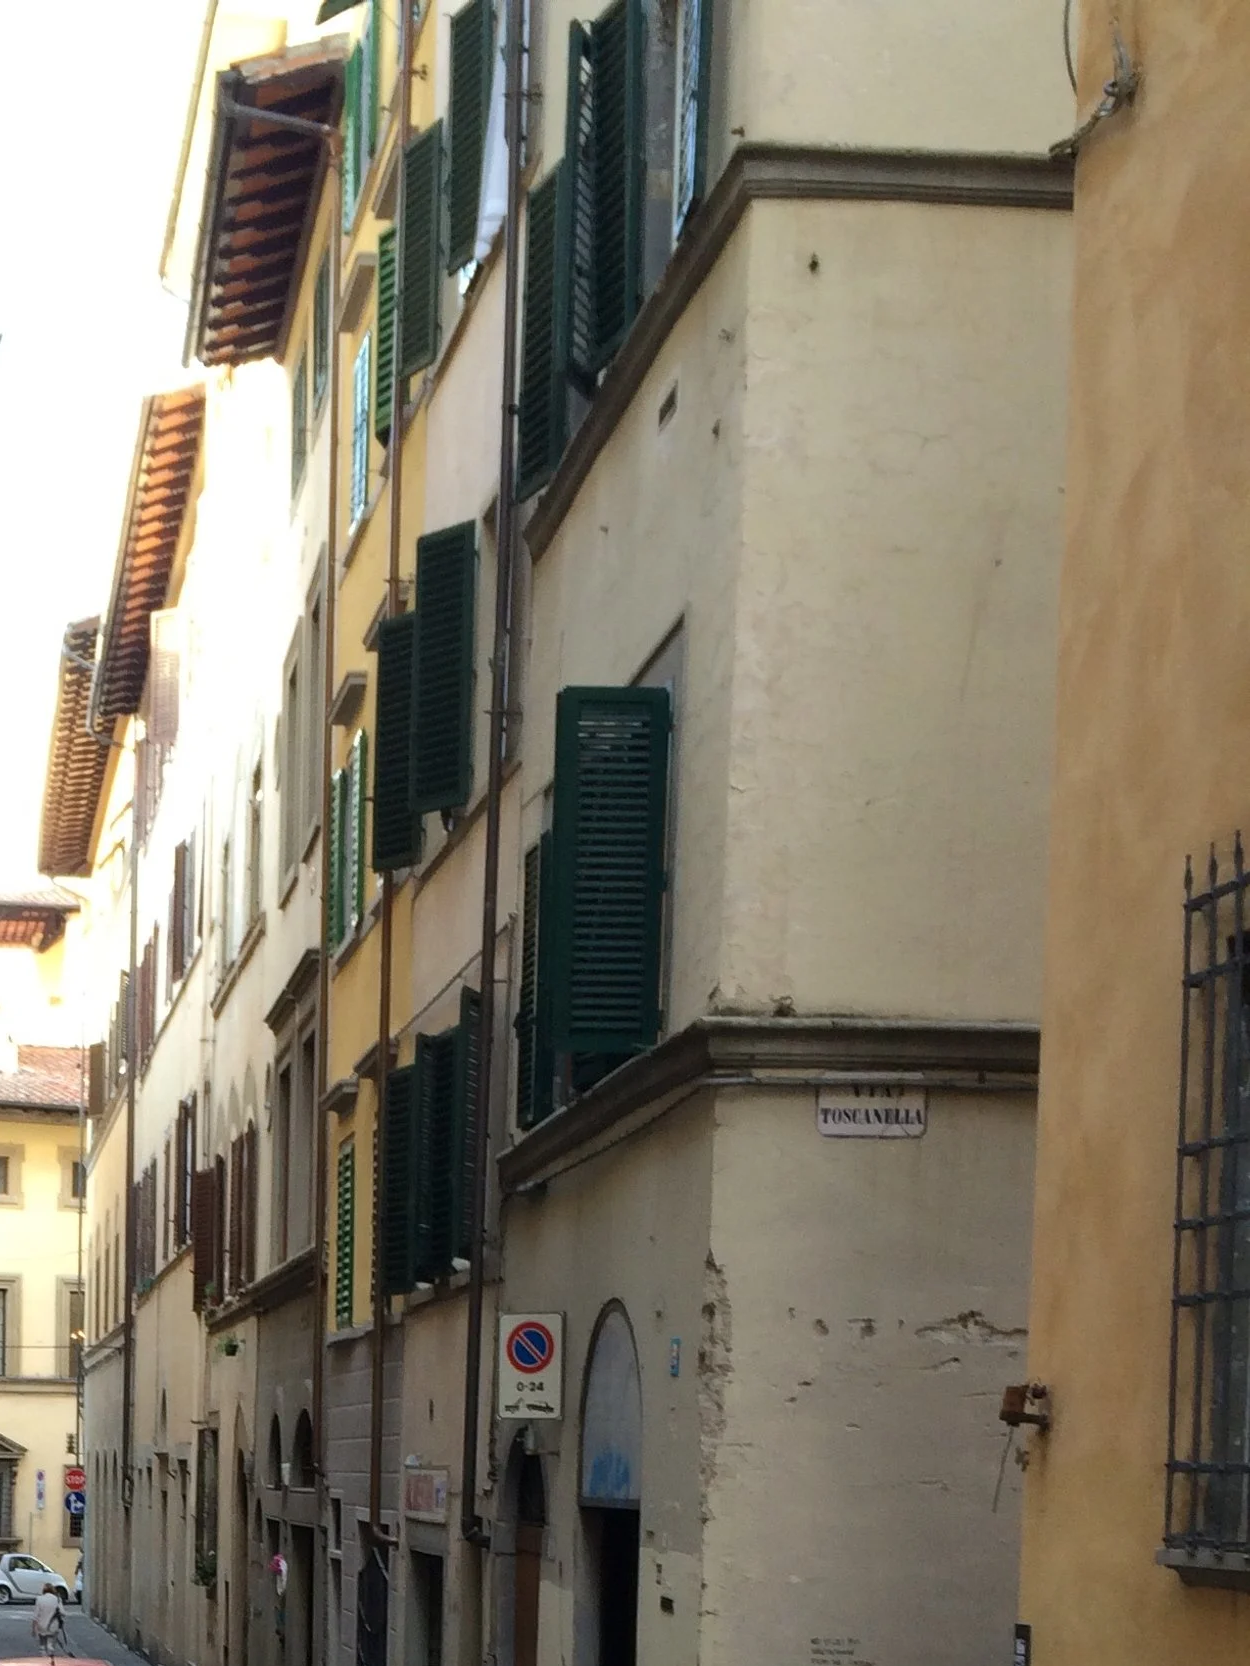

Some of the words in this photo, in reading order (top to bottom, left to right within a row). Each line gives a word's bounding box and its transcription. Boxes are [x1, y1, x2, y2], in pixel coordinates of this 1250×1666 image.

[820, 1107, 924, 1125] TOSCANELLA
[516, 1381, 545, 1392] 0-24
[66, 1474, 85, 1485] STOP
